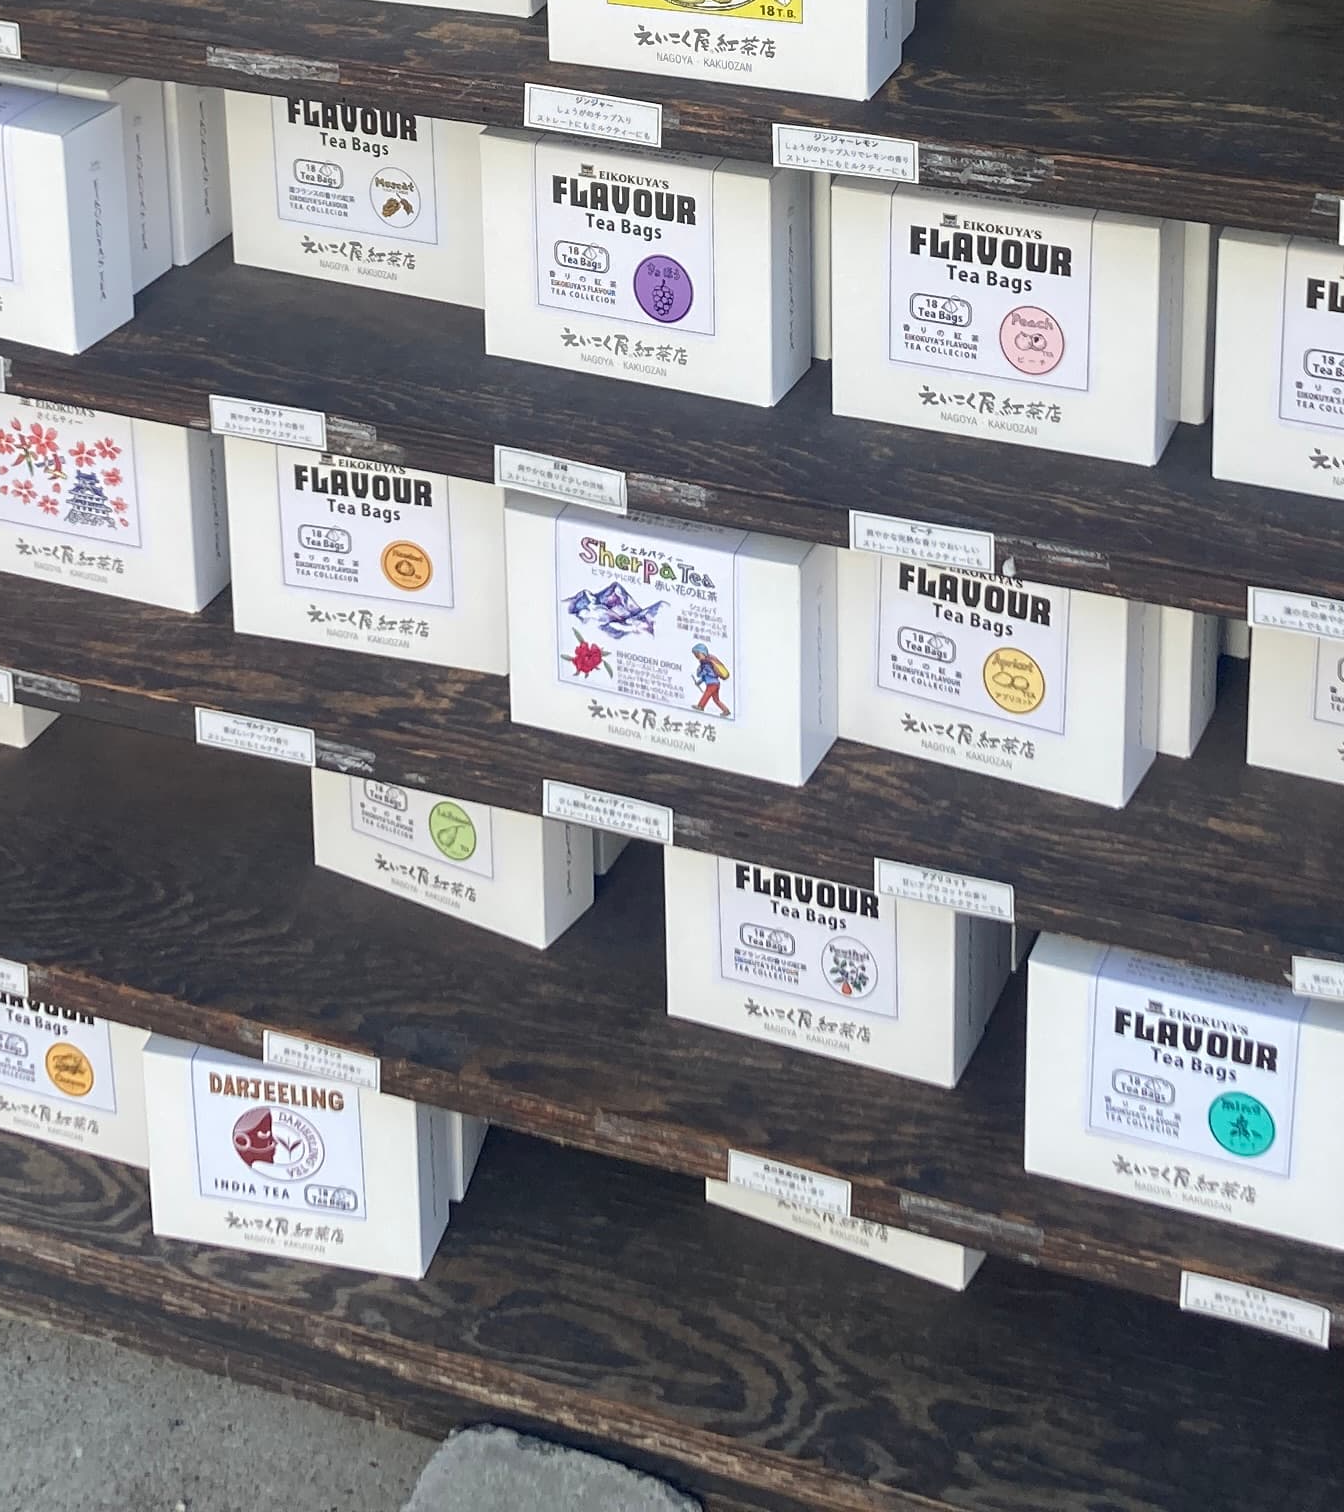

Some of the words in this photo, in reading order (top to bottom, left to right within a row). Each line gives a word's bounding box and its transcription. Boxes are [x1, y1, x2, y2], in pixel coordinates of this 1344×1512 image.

[287, 99, 418, 143] FLAVOUR
[319, 132, 347, 150] Tea
[351, 138, 390, 158] Bags
[553, 175, 697, 226] FLAVOUR
[910, 225, 1072, 276] FLAVOUR
[946, 264, 982, 284] Tea
[986, 269, 1033, 294] Bags
[294, 463, 434, 508] FLAVOUR
[579, 536, 677, 585] Sherpa
[678, 562, 716, 589] Tea
[898, 563, 1051, 626] FLAVOUR
[735, 864, 881, 920] FLAVOUR
[5, 1006, 31, 1027] Tea
[34, 1014, 68, 1037] Bags
[1113, 1006, 1279, 1073] FLAVOUR
[1150, 1047, 1184, 1069] Tea
[1190, 1055, 1238, 1084] Bags
[209, 1070, 345, 1112] DARJEELING
[213, 1178, 256, 1195] INDIA
[261, 1184, 290, 1199] TEA
